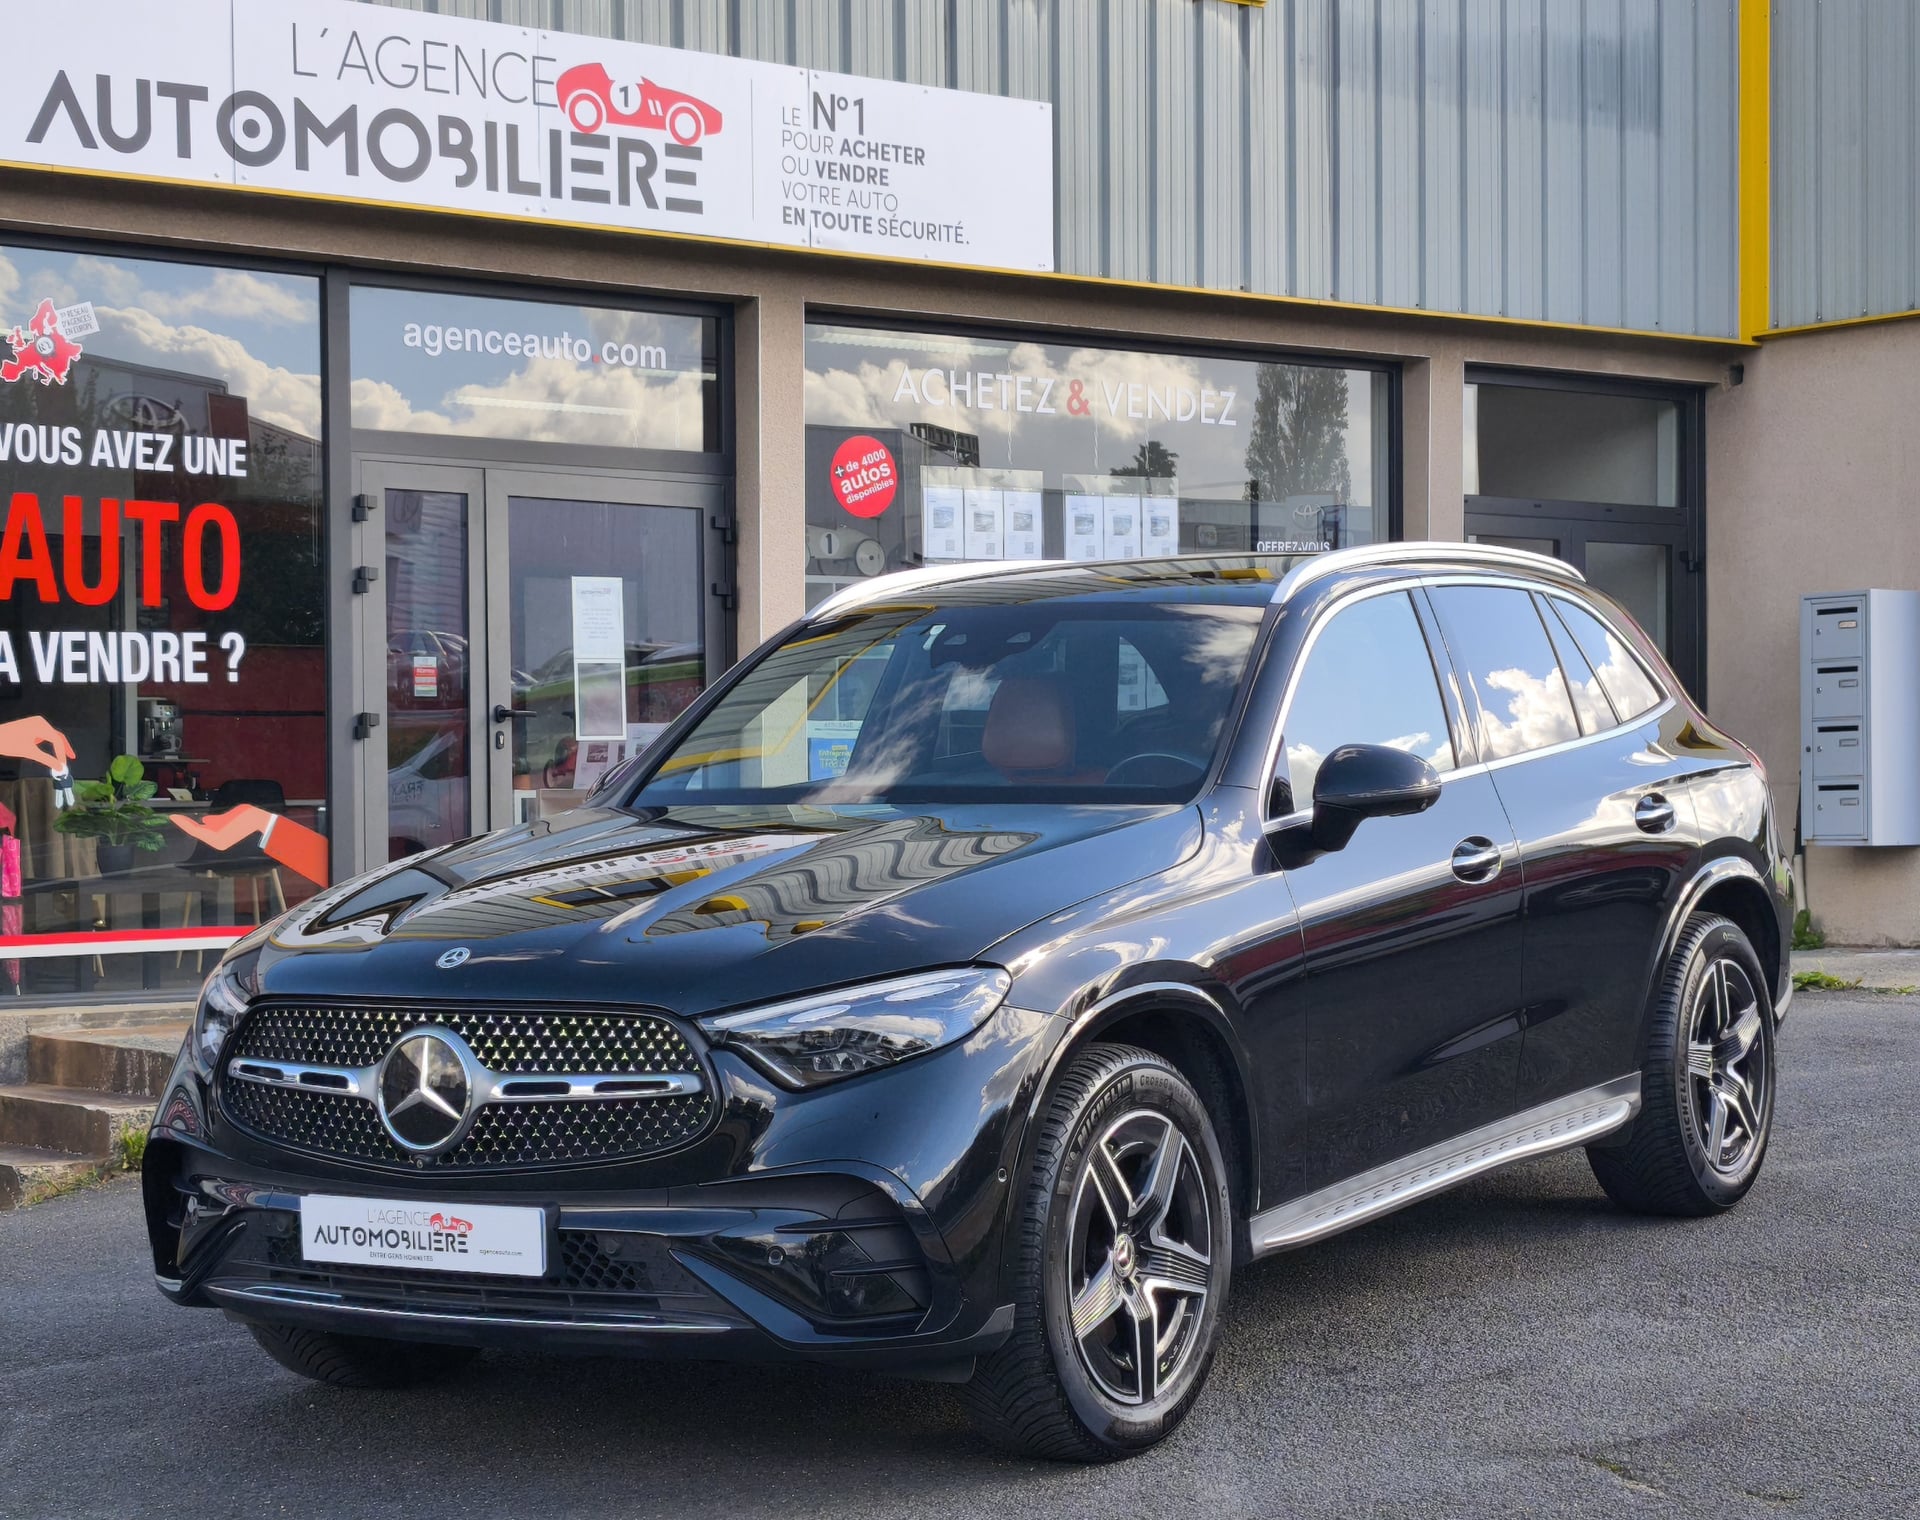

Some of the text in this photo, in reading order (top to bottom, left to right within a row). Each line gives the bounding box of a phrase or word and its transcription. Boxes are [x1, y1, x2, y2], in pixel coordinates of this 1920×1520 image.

[292, 22, 558, 108] L'AGENCE
[618, 85, 630, 108] 1
[781, 106, 801, 128] LE
[25, 69, 703, 215] AUTOMOBILIERE
[781, 130, 925, 167] POUR ACHETER
[781, 156, 889, 187] OU VENDRE
[781, 182, 899, 213] VOTRE AUTO
[782, 206, 970, 246] EN TOUTE SÉCURITÉ.
[402, 321, 667, 369] agenceauto.com
[892, 365, 1238, 427] ACHETEZ & VENDEZ
[0, 423, 248, 477] VOUS AVEZ UNE
[846, 460, 859, 473] de
[861, 448, 886, 467] 4000
[841, 462, 891, 494] autos
[846, 478, 894, 504] disponibles
[0, 492, 241, 612] AUTO
[28, 631, 209, 684] VENDRE
[220, 632, 246, 682] ?
[1077, 1076, 1132, 1149] MICHELIN
[1679, 1063, 1695, 1146] MICHELIN
[367, 1208, 430, 1227] L'AGENCE
[314, 1224, 469, 1254] AUTOMOBILIERE
